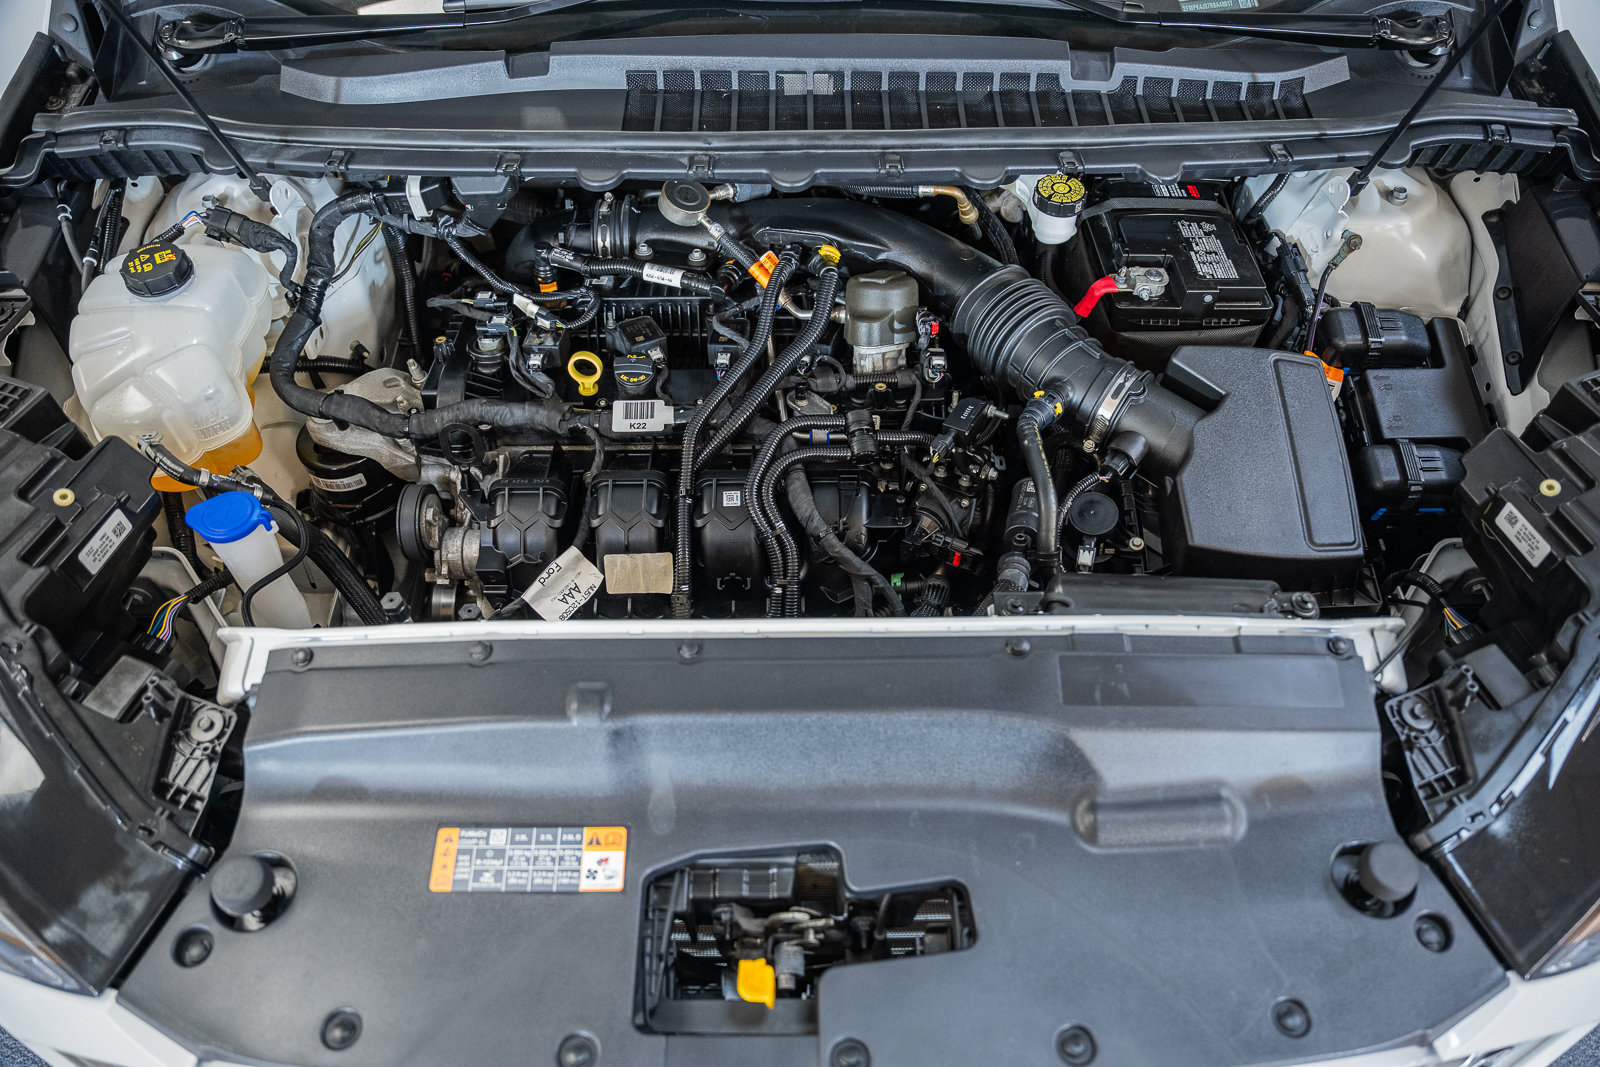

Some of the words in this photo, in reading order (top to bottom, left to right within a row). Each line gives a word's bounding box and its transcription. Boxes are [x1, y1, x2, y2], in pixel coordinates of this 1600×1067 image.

[629, 422, 647, 430] K22
[538, 562, 562, 587] Ford
[557, 581, 582, 605] AAA
